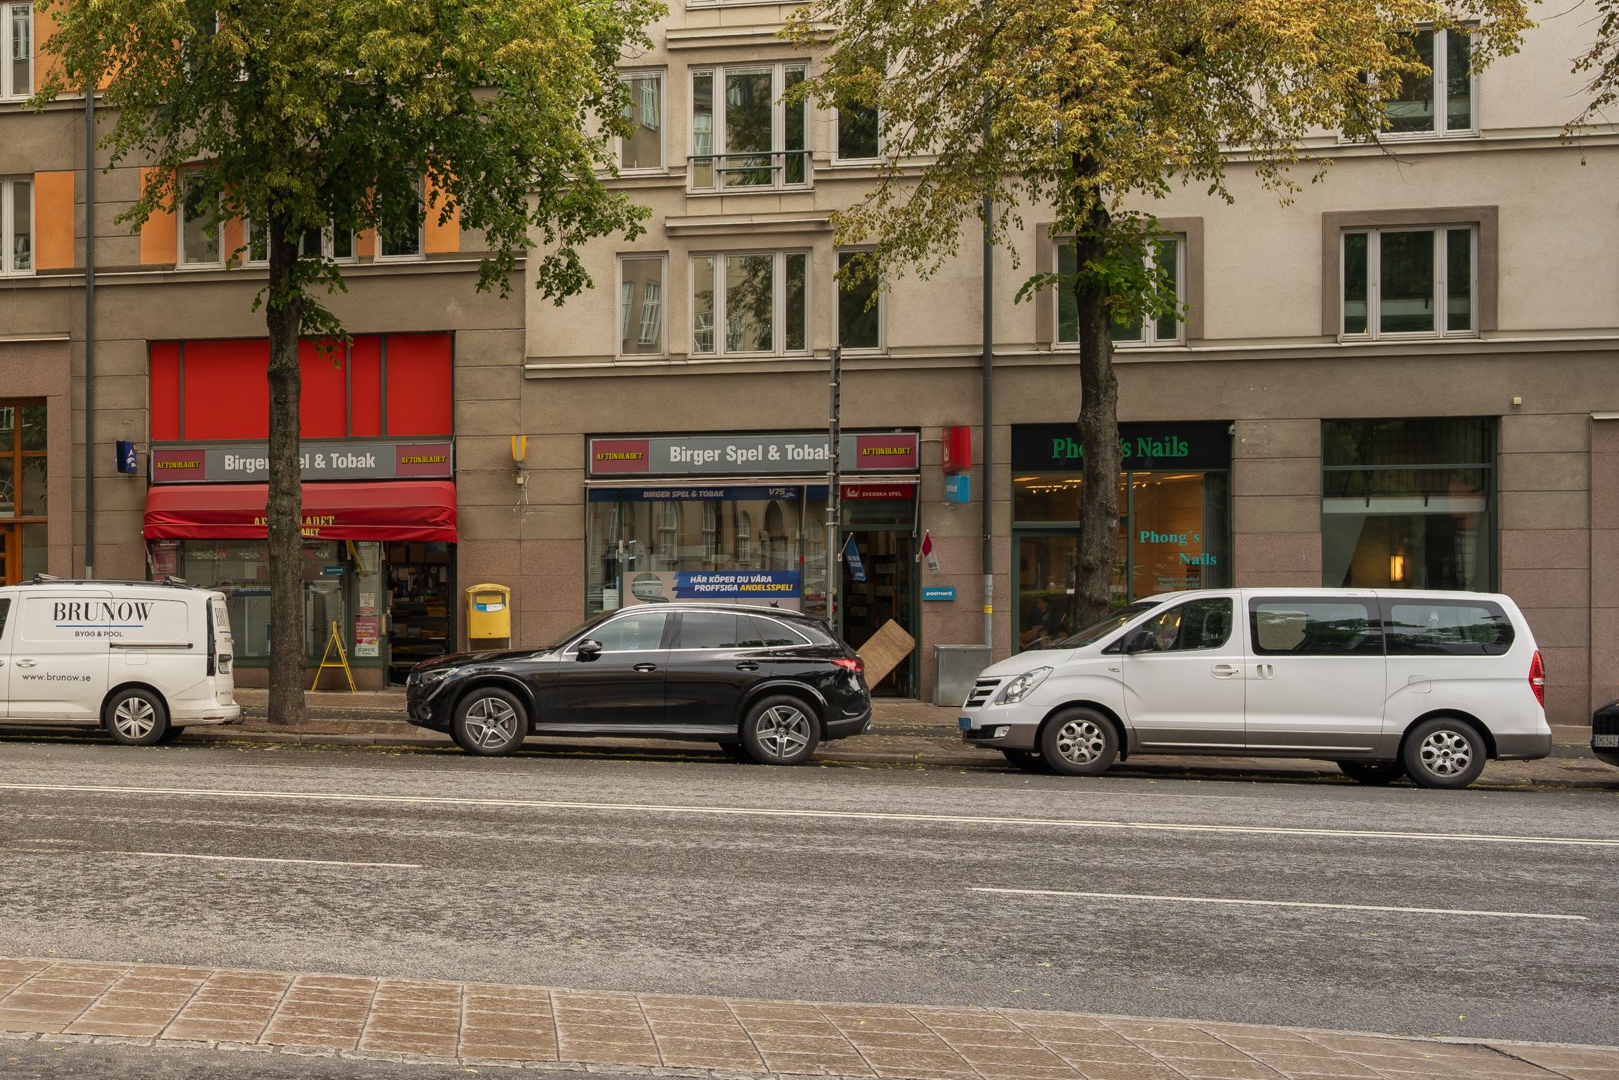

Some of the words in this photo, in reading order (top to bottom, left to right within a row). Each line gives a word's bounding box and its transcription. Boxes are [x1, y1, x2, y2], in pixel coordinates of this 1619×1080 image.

[862, 446, 912, 456] AFTONBLADET
[1136, 435, 1189, 457] Nails
[400, 455, 447, 465] AFTONBLADET
[595, 451, 644, 461] AFTONBLADET
[670, 446, 722, 466] Birger
[726, 445, 763, 464] Spel
[767, 445, 781, 461] &
[156, 460, 201, 470] AFTONBLADET
[224, 454, 270, 473] Birger
[314, 453, 326, 469] &
[330, 452, 376, 468] Tobak
[768, 487, 786, 496] V75
[253, 515, 335, 526] AFADET
[1179, 552, 1218, 566] Nails
[690, 575, 708, 583] HÄR
[709, 574, 736, 583] KÖPER
[736, 575, 749, 583] DU
[750, 573, 773, 583] VÅRA
[694, 583, 739, 592] PROFFSIGA
[739, 583, 793, 592] ANDELSSPEL!
[53, 601, 156, 622] BRUNOW
[22, 672, 92, 682] www.brunow.se
